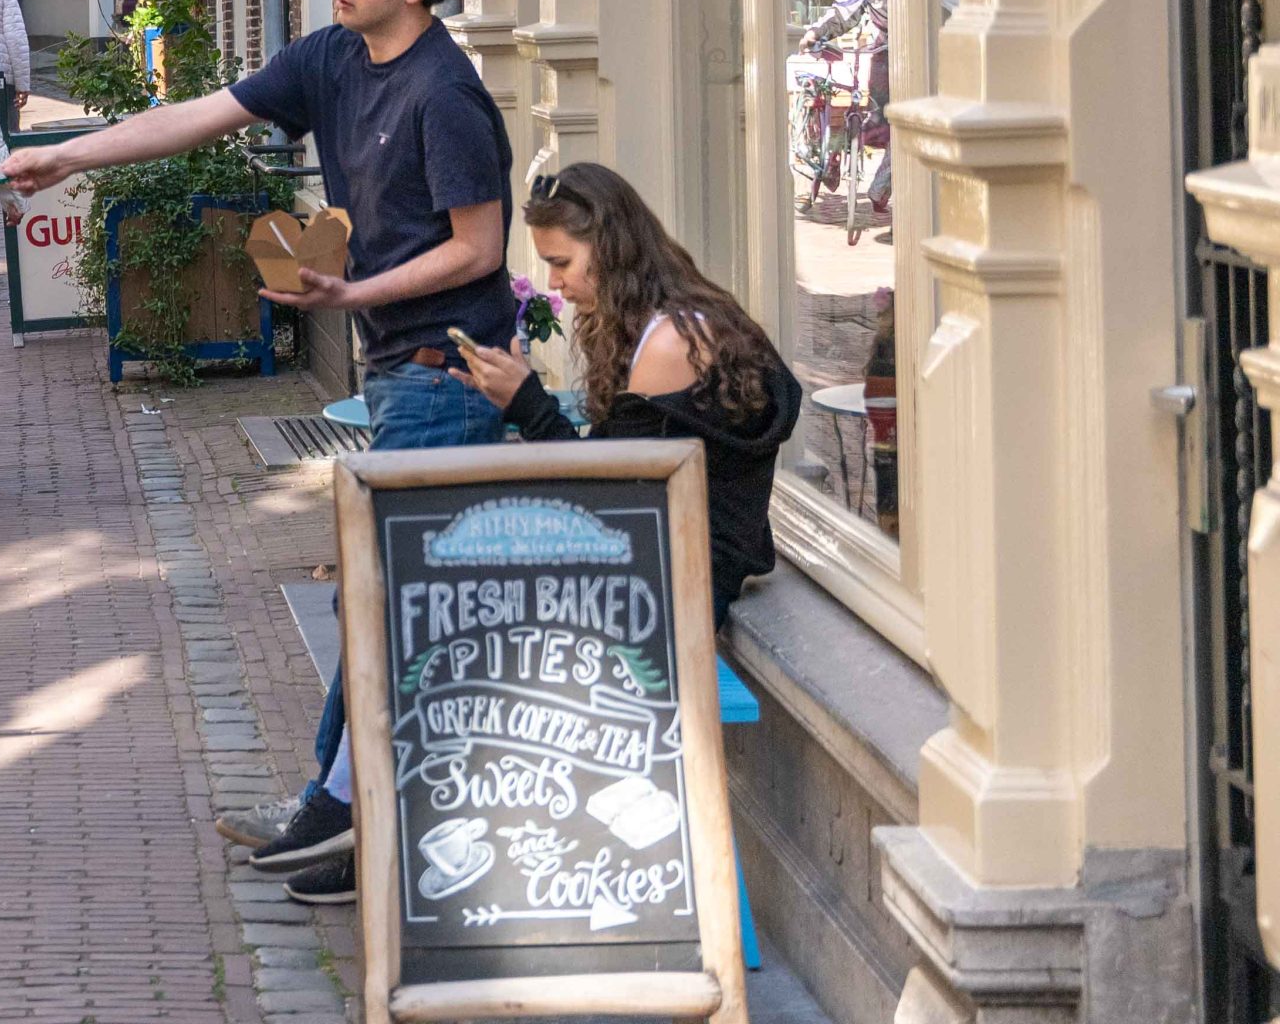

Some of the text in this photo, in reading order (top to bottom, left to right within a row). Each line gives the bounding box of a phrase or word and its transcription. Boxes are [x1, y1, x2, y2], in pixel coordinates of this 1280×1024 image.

[25, 214, 86, 248] GUL
[469, 513, 586, 538] RITHYMNA
[400, 575, 658, 662] FRESH BAKED
[448, 626, 604, 686] PITES
[426, 694, 507, 738] GREEK
[507, 701, 590, 754] COFFEE
[593, 722, 646, 769] TEA
[520, 846, 684, 910] Cookies
